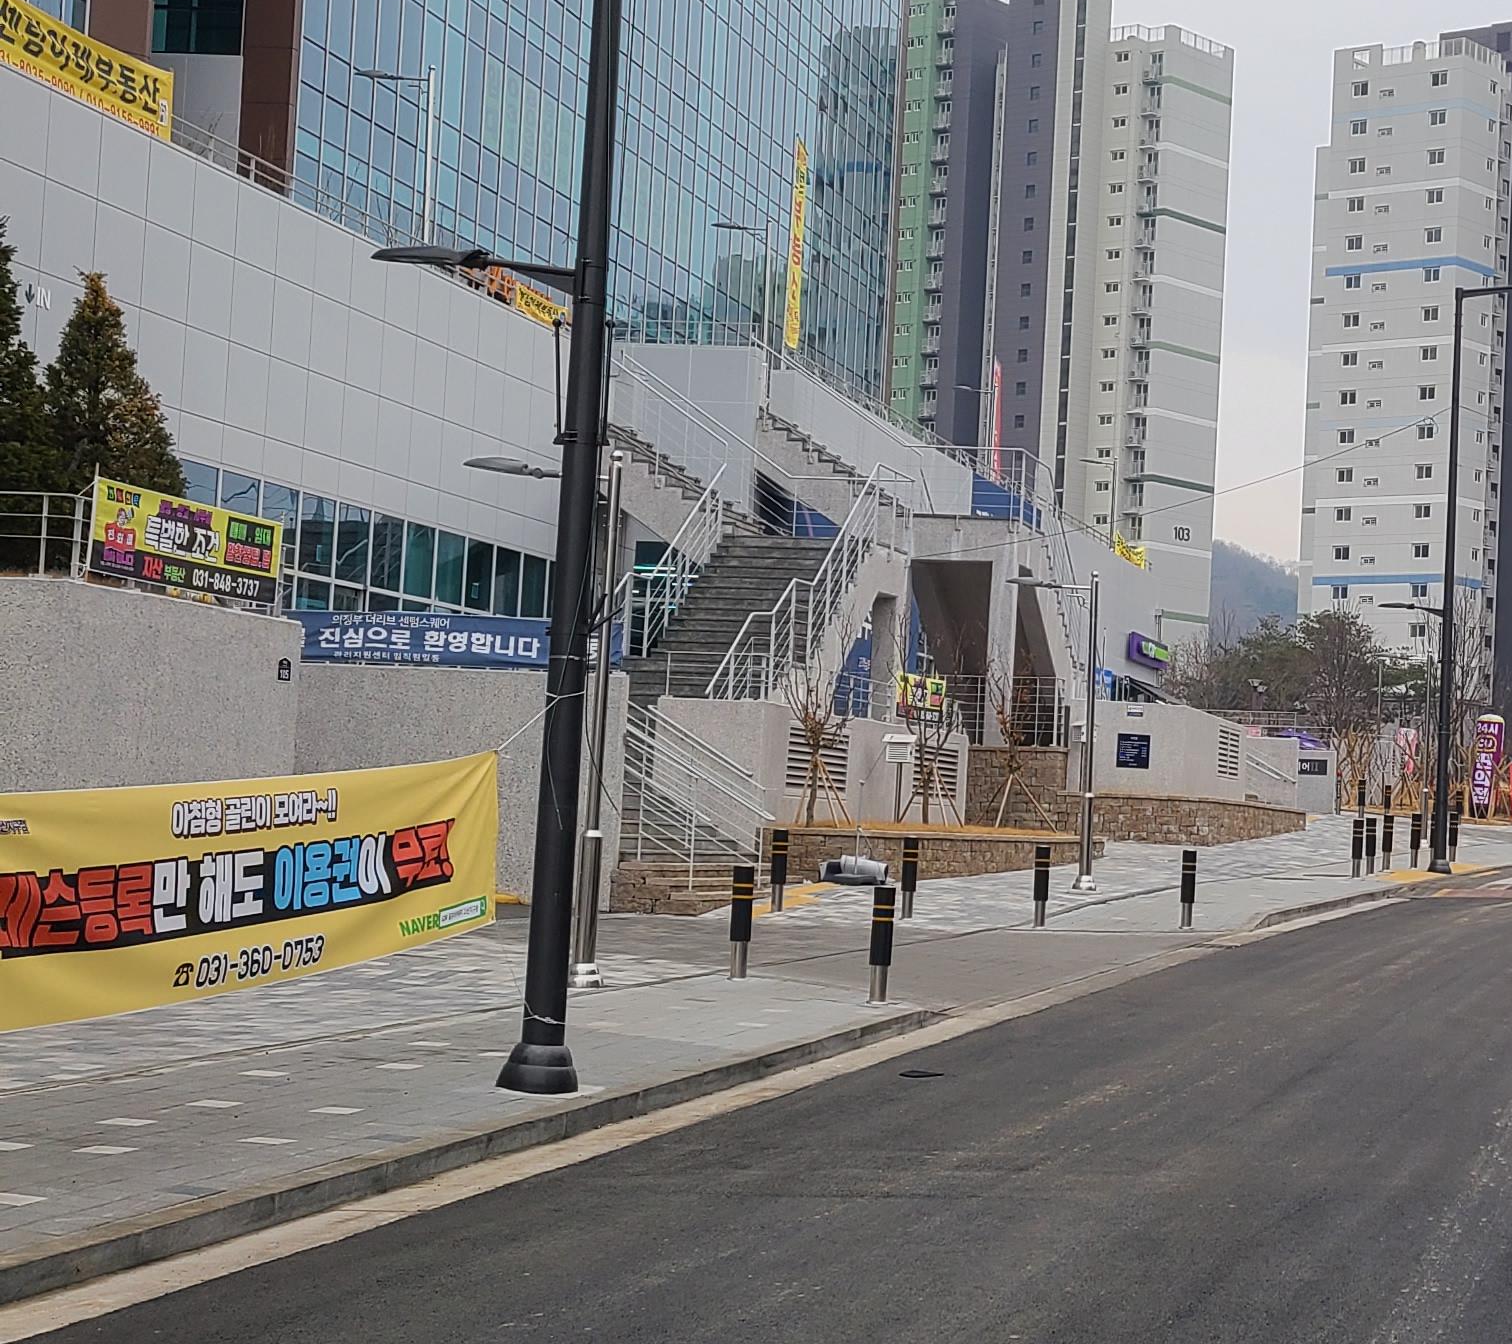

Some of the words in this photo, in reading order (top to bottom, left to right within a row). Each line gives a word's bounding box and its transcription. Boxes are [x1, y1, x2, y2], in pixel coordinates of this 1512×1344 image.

[37, 287, 51, 310] IN
[144, 515, 189, 557] 특별한
[192, 528, 219, 563] 조건
[1173, 526, 1190, 541] 103
[192, 568, 259, 597] 031-848-3737
[332, 613, 363, 625] 의정부
[365, 613, 396, 625] 더리브
[399, 615, 450, 629] 센텀스퀘어
[318, 627, 411, 650] 진심으로
[423, 630, 540, 659] 환영합니다
[171, 799, 222, 837] 아침형
[224, 794, 272, 834] 골린이
[199, 848, 265, 924] 해도
[274, 832, 391, 911] 이용권이
[392, 818, 455, 889] 무료!
[399, 913, 440, 937] NAVER
[195, 935, 325, 988] 031-360-0753
